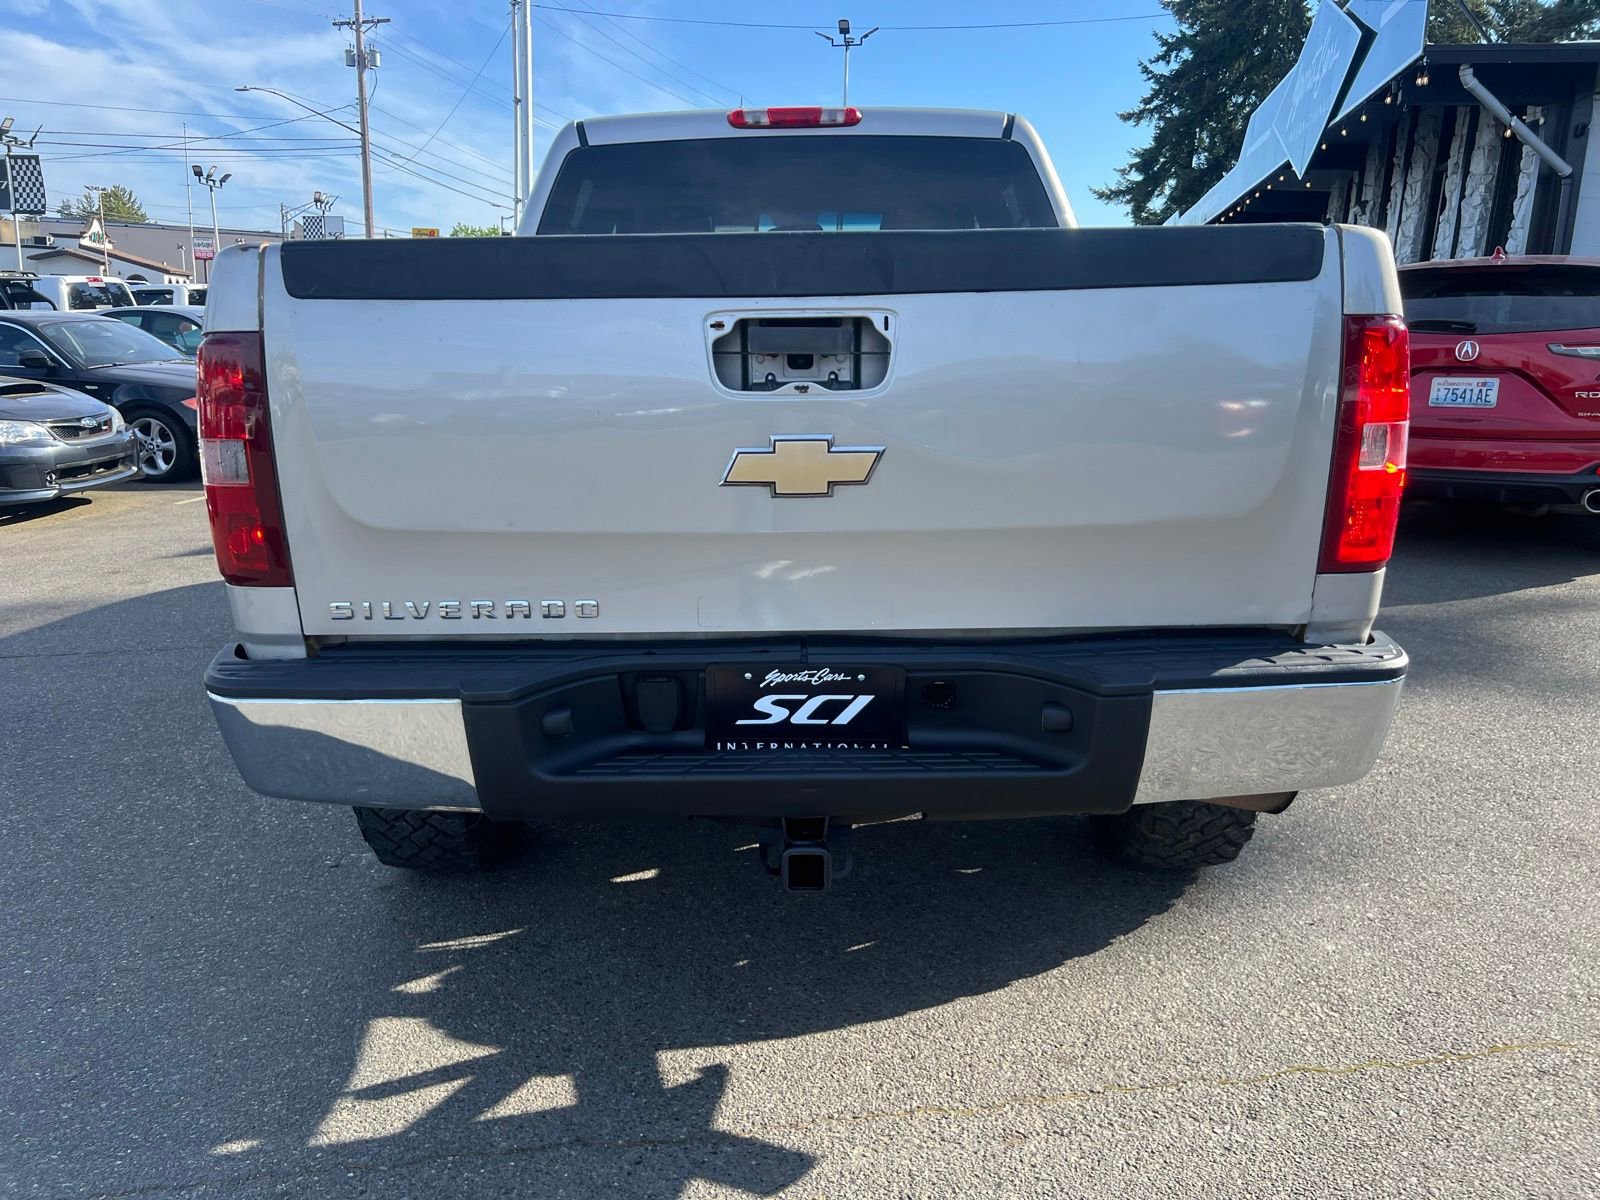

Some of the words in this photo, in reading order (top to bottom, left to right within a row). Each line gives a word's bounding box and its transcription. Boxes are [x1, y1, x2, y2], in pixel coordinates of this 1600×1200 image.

[1443, 387, 1493, 403] 7541AE
[329, 599, 600, 620] SILVERADO
[759, 669, 815, 688] Sports
[811, 668, 852, 685] Cars
[735, 694, 875, 725] SCI
